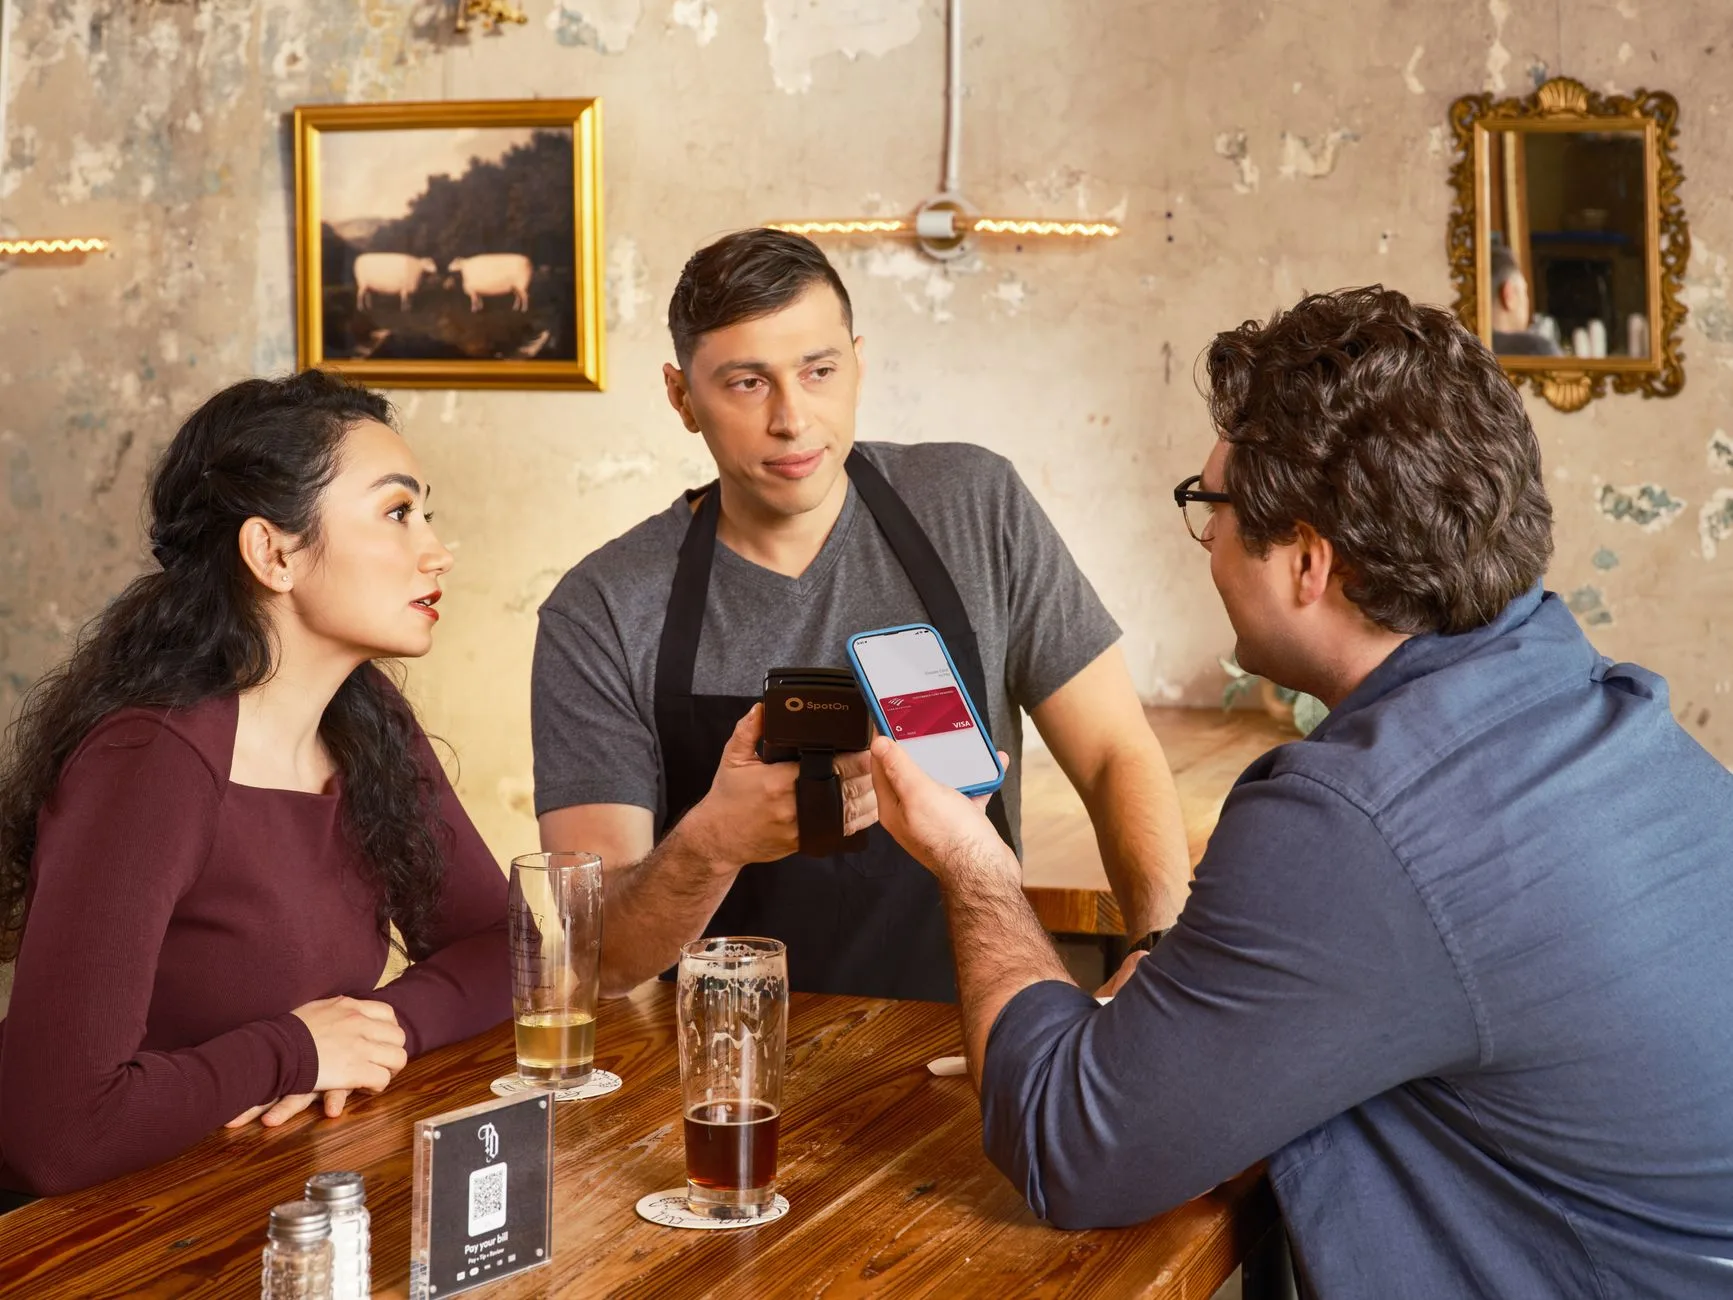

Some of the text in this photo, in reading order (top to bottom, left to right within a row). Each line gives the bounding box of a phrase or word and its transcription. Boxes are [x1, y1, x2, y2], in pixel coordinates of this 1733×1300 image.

[806, 701, 849, 710] SpotOn
[952, 720, 971, 728] VISA
[464, 1231, 508, 1255] Pay your bill
